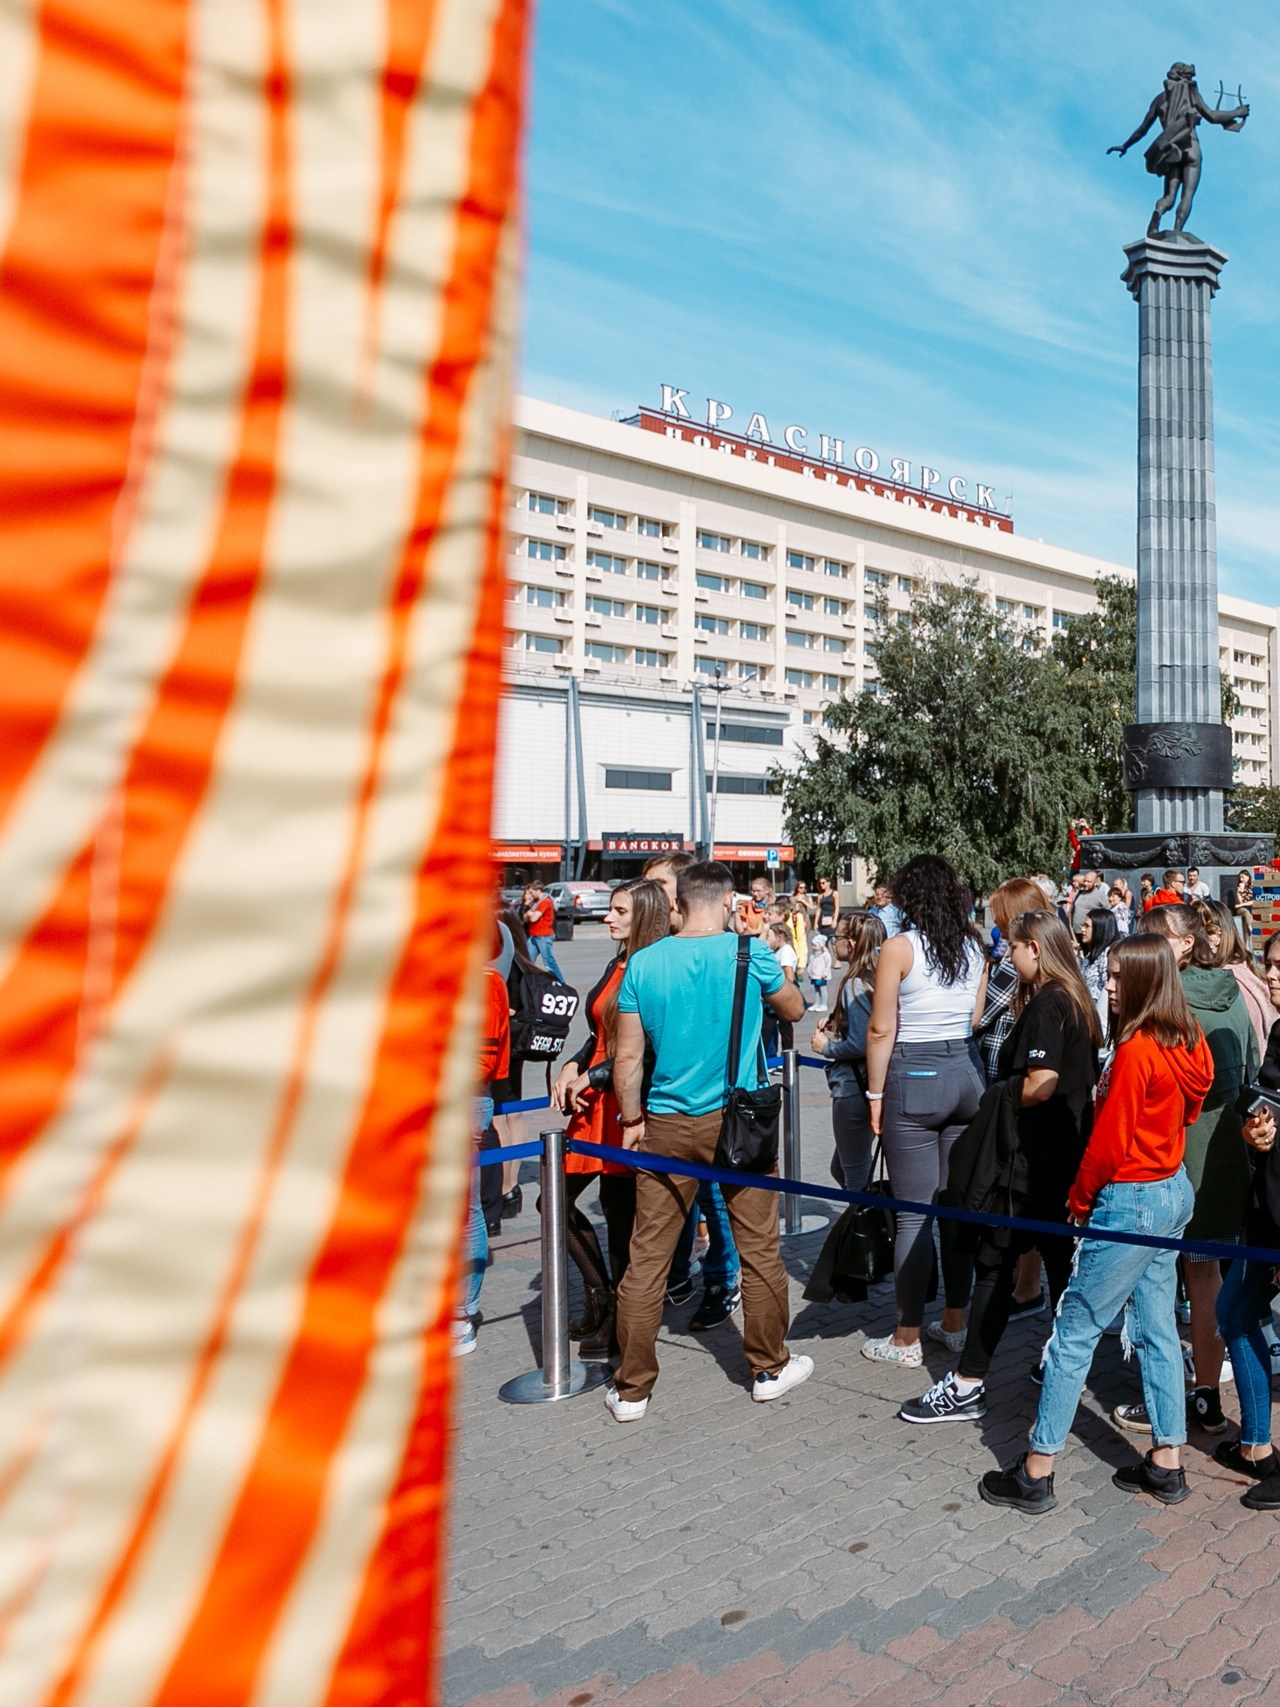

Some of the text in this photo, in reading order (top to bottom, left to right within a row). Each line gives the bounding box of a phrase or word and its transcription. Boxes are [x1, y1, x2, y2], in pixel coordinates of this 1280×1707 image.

[660, 383, 997, 510] КРАСНОЯРСК
[608, 840, 680, 850] BANGKOK
[541, 993, 578, 1017] 937
